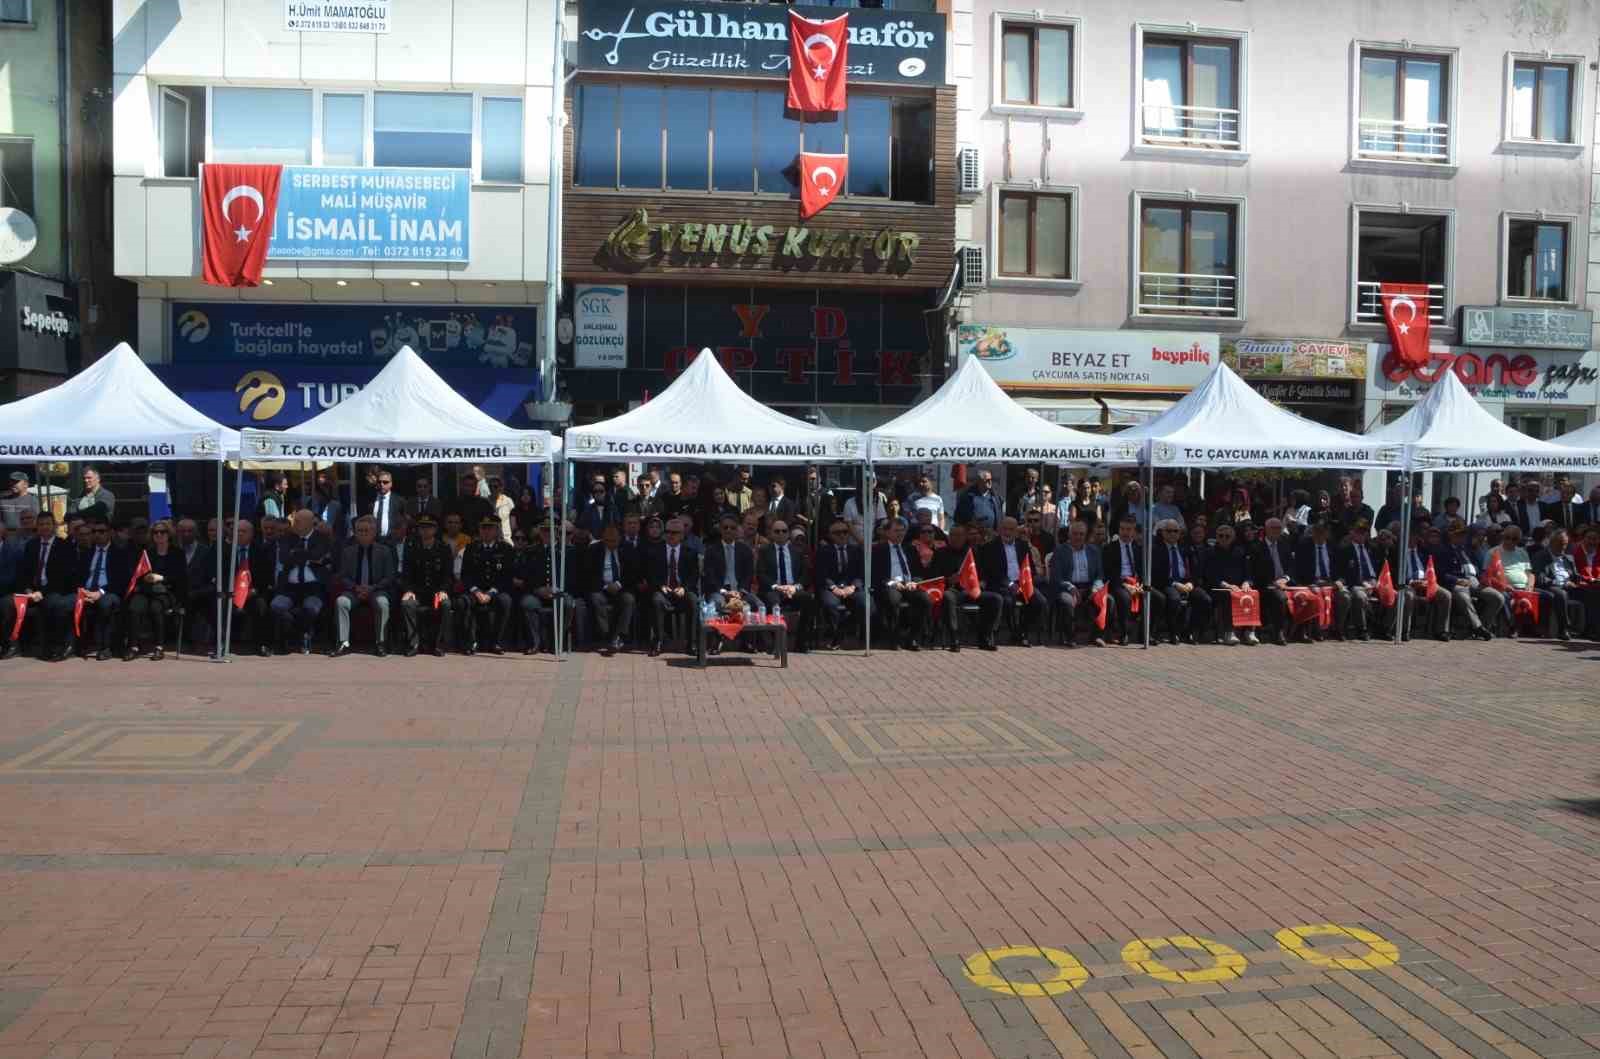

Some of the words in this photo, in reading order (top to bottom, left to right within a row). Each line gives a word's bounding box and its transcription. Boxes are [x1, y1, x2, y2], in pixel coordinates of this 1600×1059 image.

[324, 4, 386, 19] MAMATOĞLU
[645, 10, 789, 41] Gülhan
[648, 50, 750, 71] Güzellik
[292, 174, 357, 189] SERBEST
[361, 172, 456, 191] MUHASEBECİ
[321, 191, 356, 209] MALİ
[361, 193, 427, 212] MÜŞAVİR
[287, 211, 383, 241] İSMAİL
[390, 213, 462, 242] İNAM
[655, 217, 774, 256] VENÜS
[582, 297, 611, 313] SGK
[230, 321, 313, 338] Turkcell'le
[732, 304, 770, 337] Y
[811, 305, 848, 339] D
[234, 338, 293, 357] bağlan
[297, 341, 364, 357] hayata!
[1151, 342, 1211, 365] beypiliç
[1052, 352, 1106, 368] BEYAZ
[1112, 353, 1131, 368] ET
[1032, 370, 1080, 380] ÇAYCUMA
[1083, 371, 1108, 382] SATIŞ
[1110, 372, 1150, 382] NOKTASI
[50, 444, 175, 457] KAYMAKAMLIĞI
[307, 445, 381, 458] ÇAYCUMA
[386, 445, 507, 458] KAYMAKAMLIĞI
[633, 442, 707, 455] ÇAYCUMA
[712, 442, 827, 456] KAYMAKAMLIĞI
[930, 447, 996, 459] ÇAYCUMA
[1002, 447, 1105, 459] KAYMAKAMLIĞI
[1207, 448, 1269, 461] ÇAYCUMA
[1273, 449, 1369, 461] KAYMAKAMLIĞI
